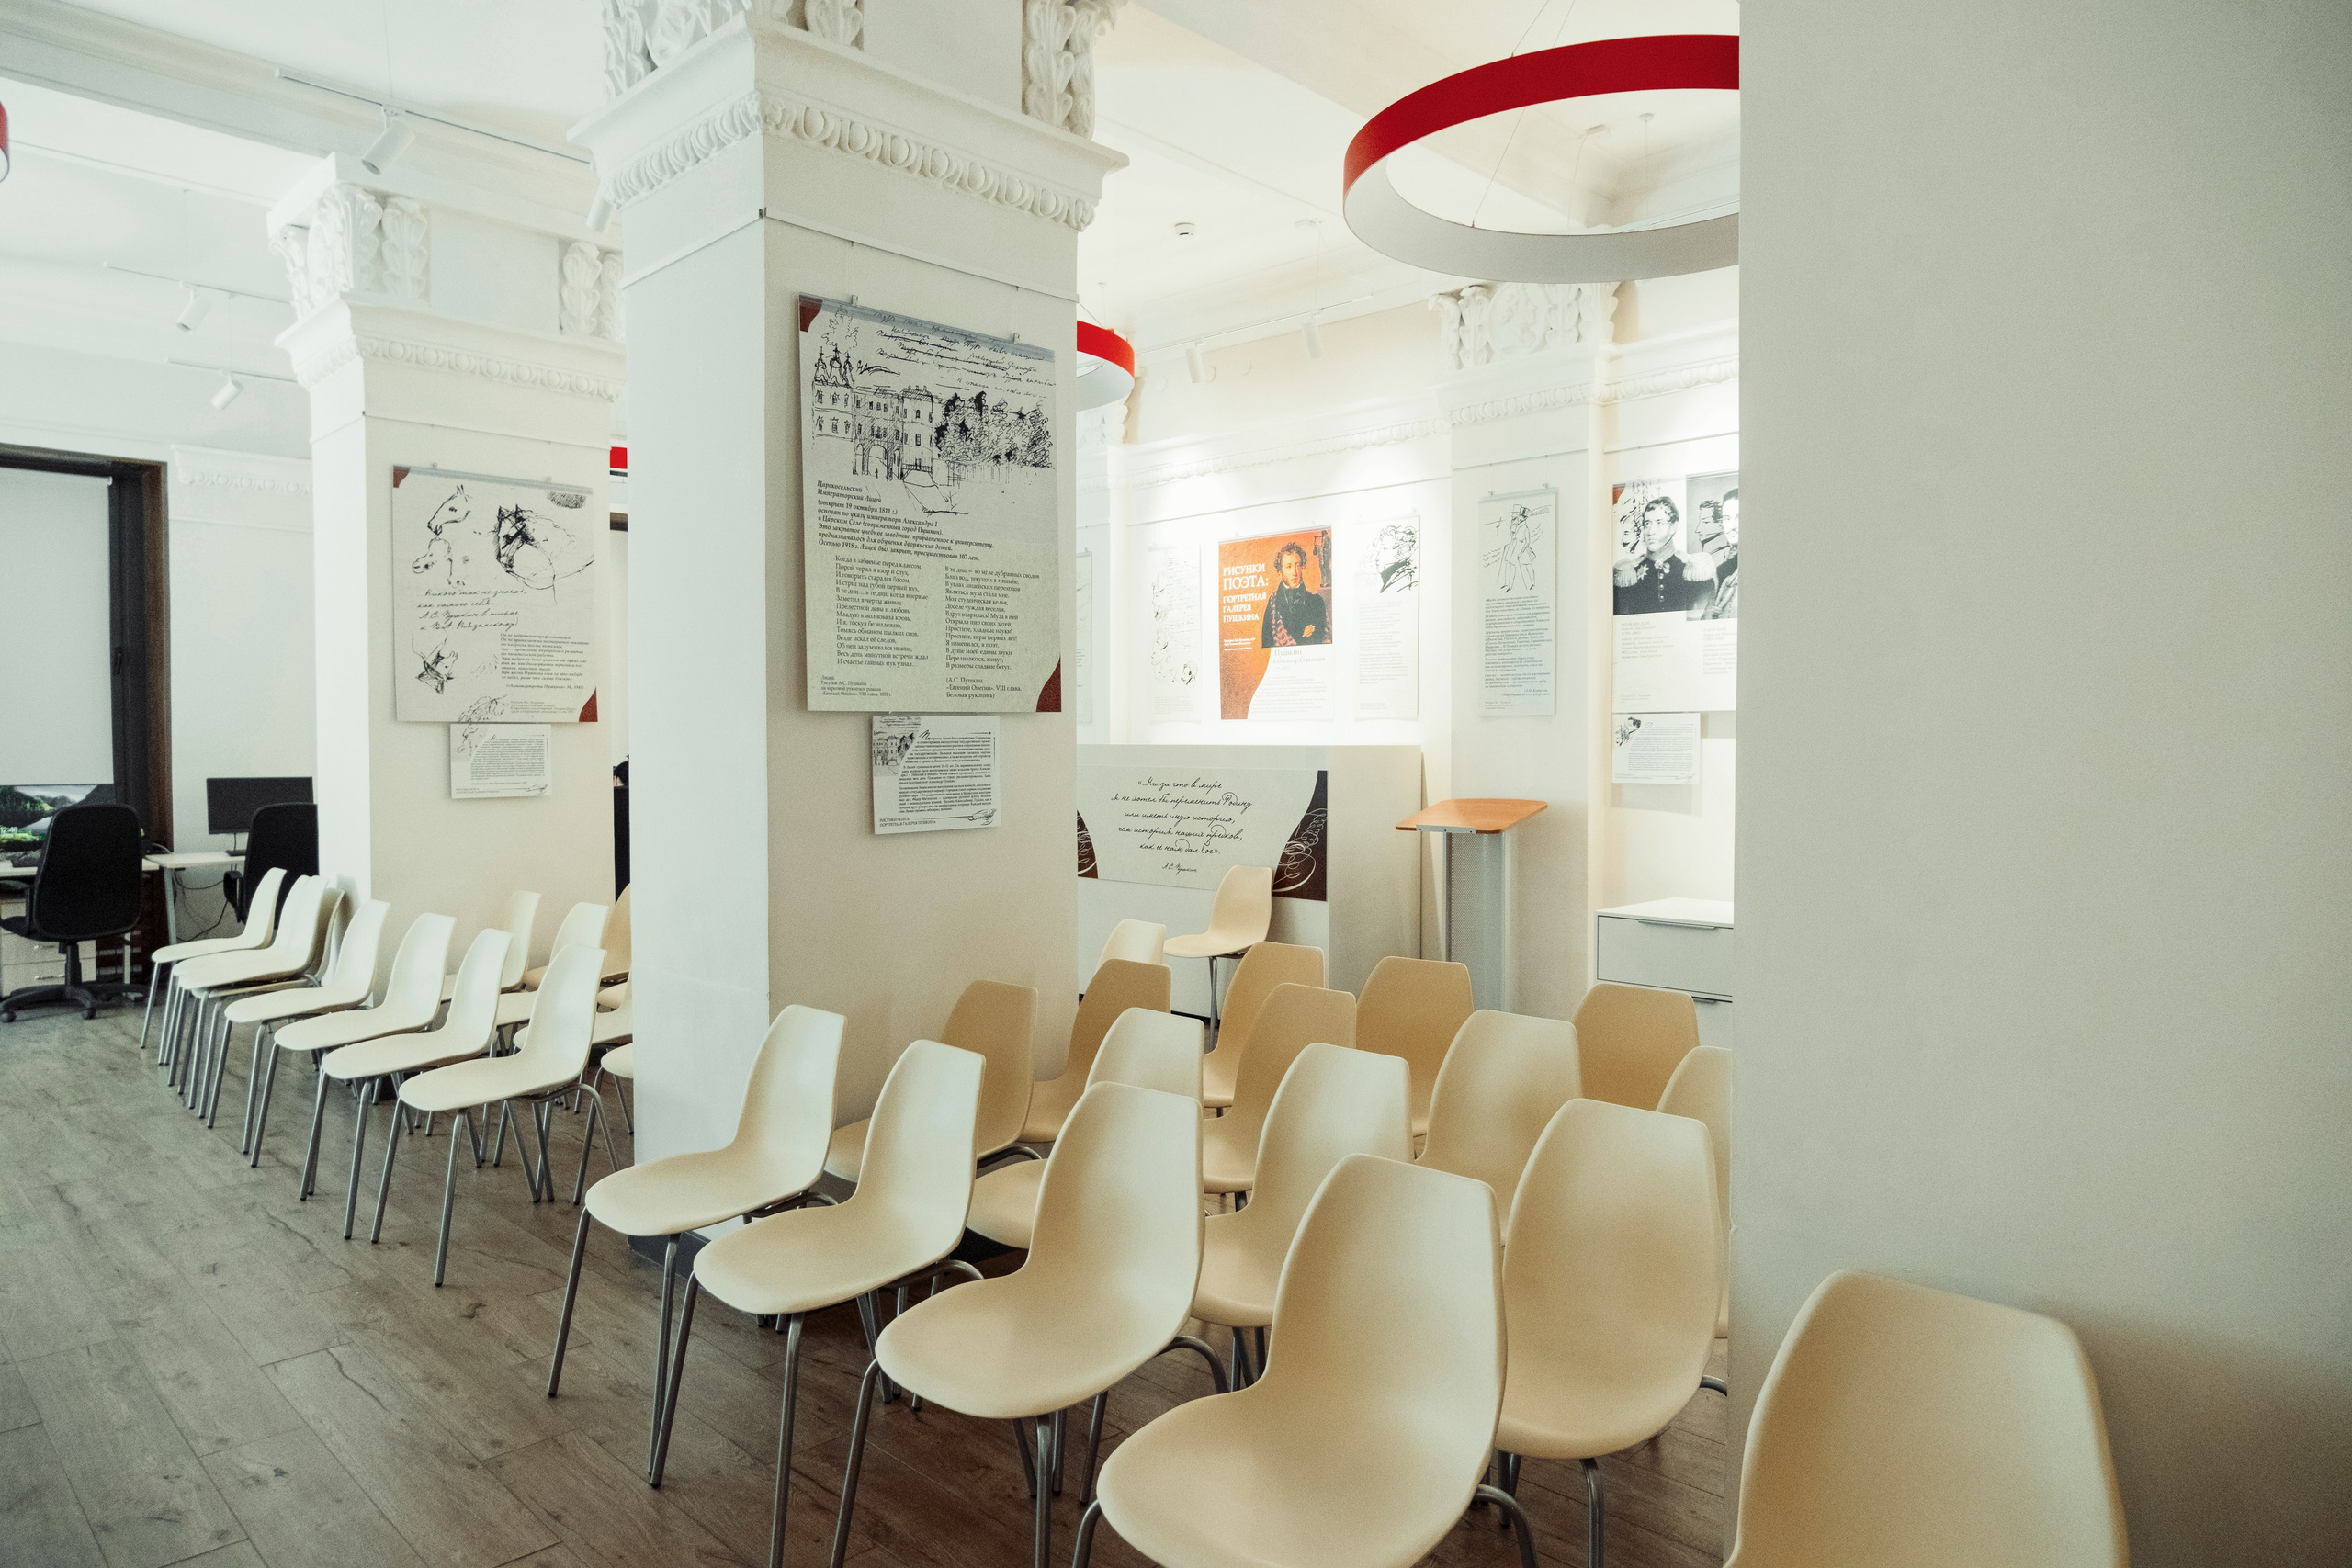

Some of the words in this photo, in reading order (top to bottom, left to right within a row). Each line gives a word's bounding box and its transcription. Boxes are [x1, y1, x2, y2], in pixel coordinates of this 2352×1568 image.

[817, 481, 862, 492] Царскосельский
[818, 489, 864, 501] Императорский
[864, 494, 882, 504] Лицей
[818, 499, 845, 509] (открыт
[853, 504, 878, 513] октября
[822, 516, 848, 525] Царском
[862, 520, 901, 530] (современный
[902, 526, 917, 534] город
[867, 515, 902, 524] императора
[902, 517, 934, 528] Александра
[866, 536, 876, 544] для
[877, 537, 903, 546] обучения
[904, 540, 934, 549] дворянских
[935, 543, 952, 551] детей.
[884, 531, 911, 541] заведение,
[912, 535, 949, 543] приравненное
[954, 540, 994, 550] университету,
[860, 543, 877, 552] Лицей
[914, 550, 958, 559] просуществовав
[1223, 563, 1266, 576] РИСУНКИ
[1223, 575, 1268, 590] ПОЭТА:
[1223, 592, 1267, 603] ПОРТРЕТНАЯ
[1223, 604, 1252, 613] ГАЛЕРЕЯ
[1223, 613, 1259, 623] ПУШКИНА
[1274, 649, 1302, 659] Пушкин
[1159, 782, 1170, 791] за
[1191, 777, 1200, 788] в
[1199, 781, 1222, 795] мире
[1159, 793, 1170, 803] бы
[1170, 796, 1221, 809] переменить
[1222, 791, 1252, 815] Родину
[1169, 815, 1190, 827] иную
[1192, 814, 1235, 827] историю,
[1134, 827, 1173, 840] история
[1206, 824, 1243, 844] предков,
